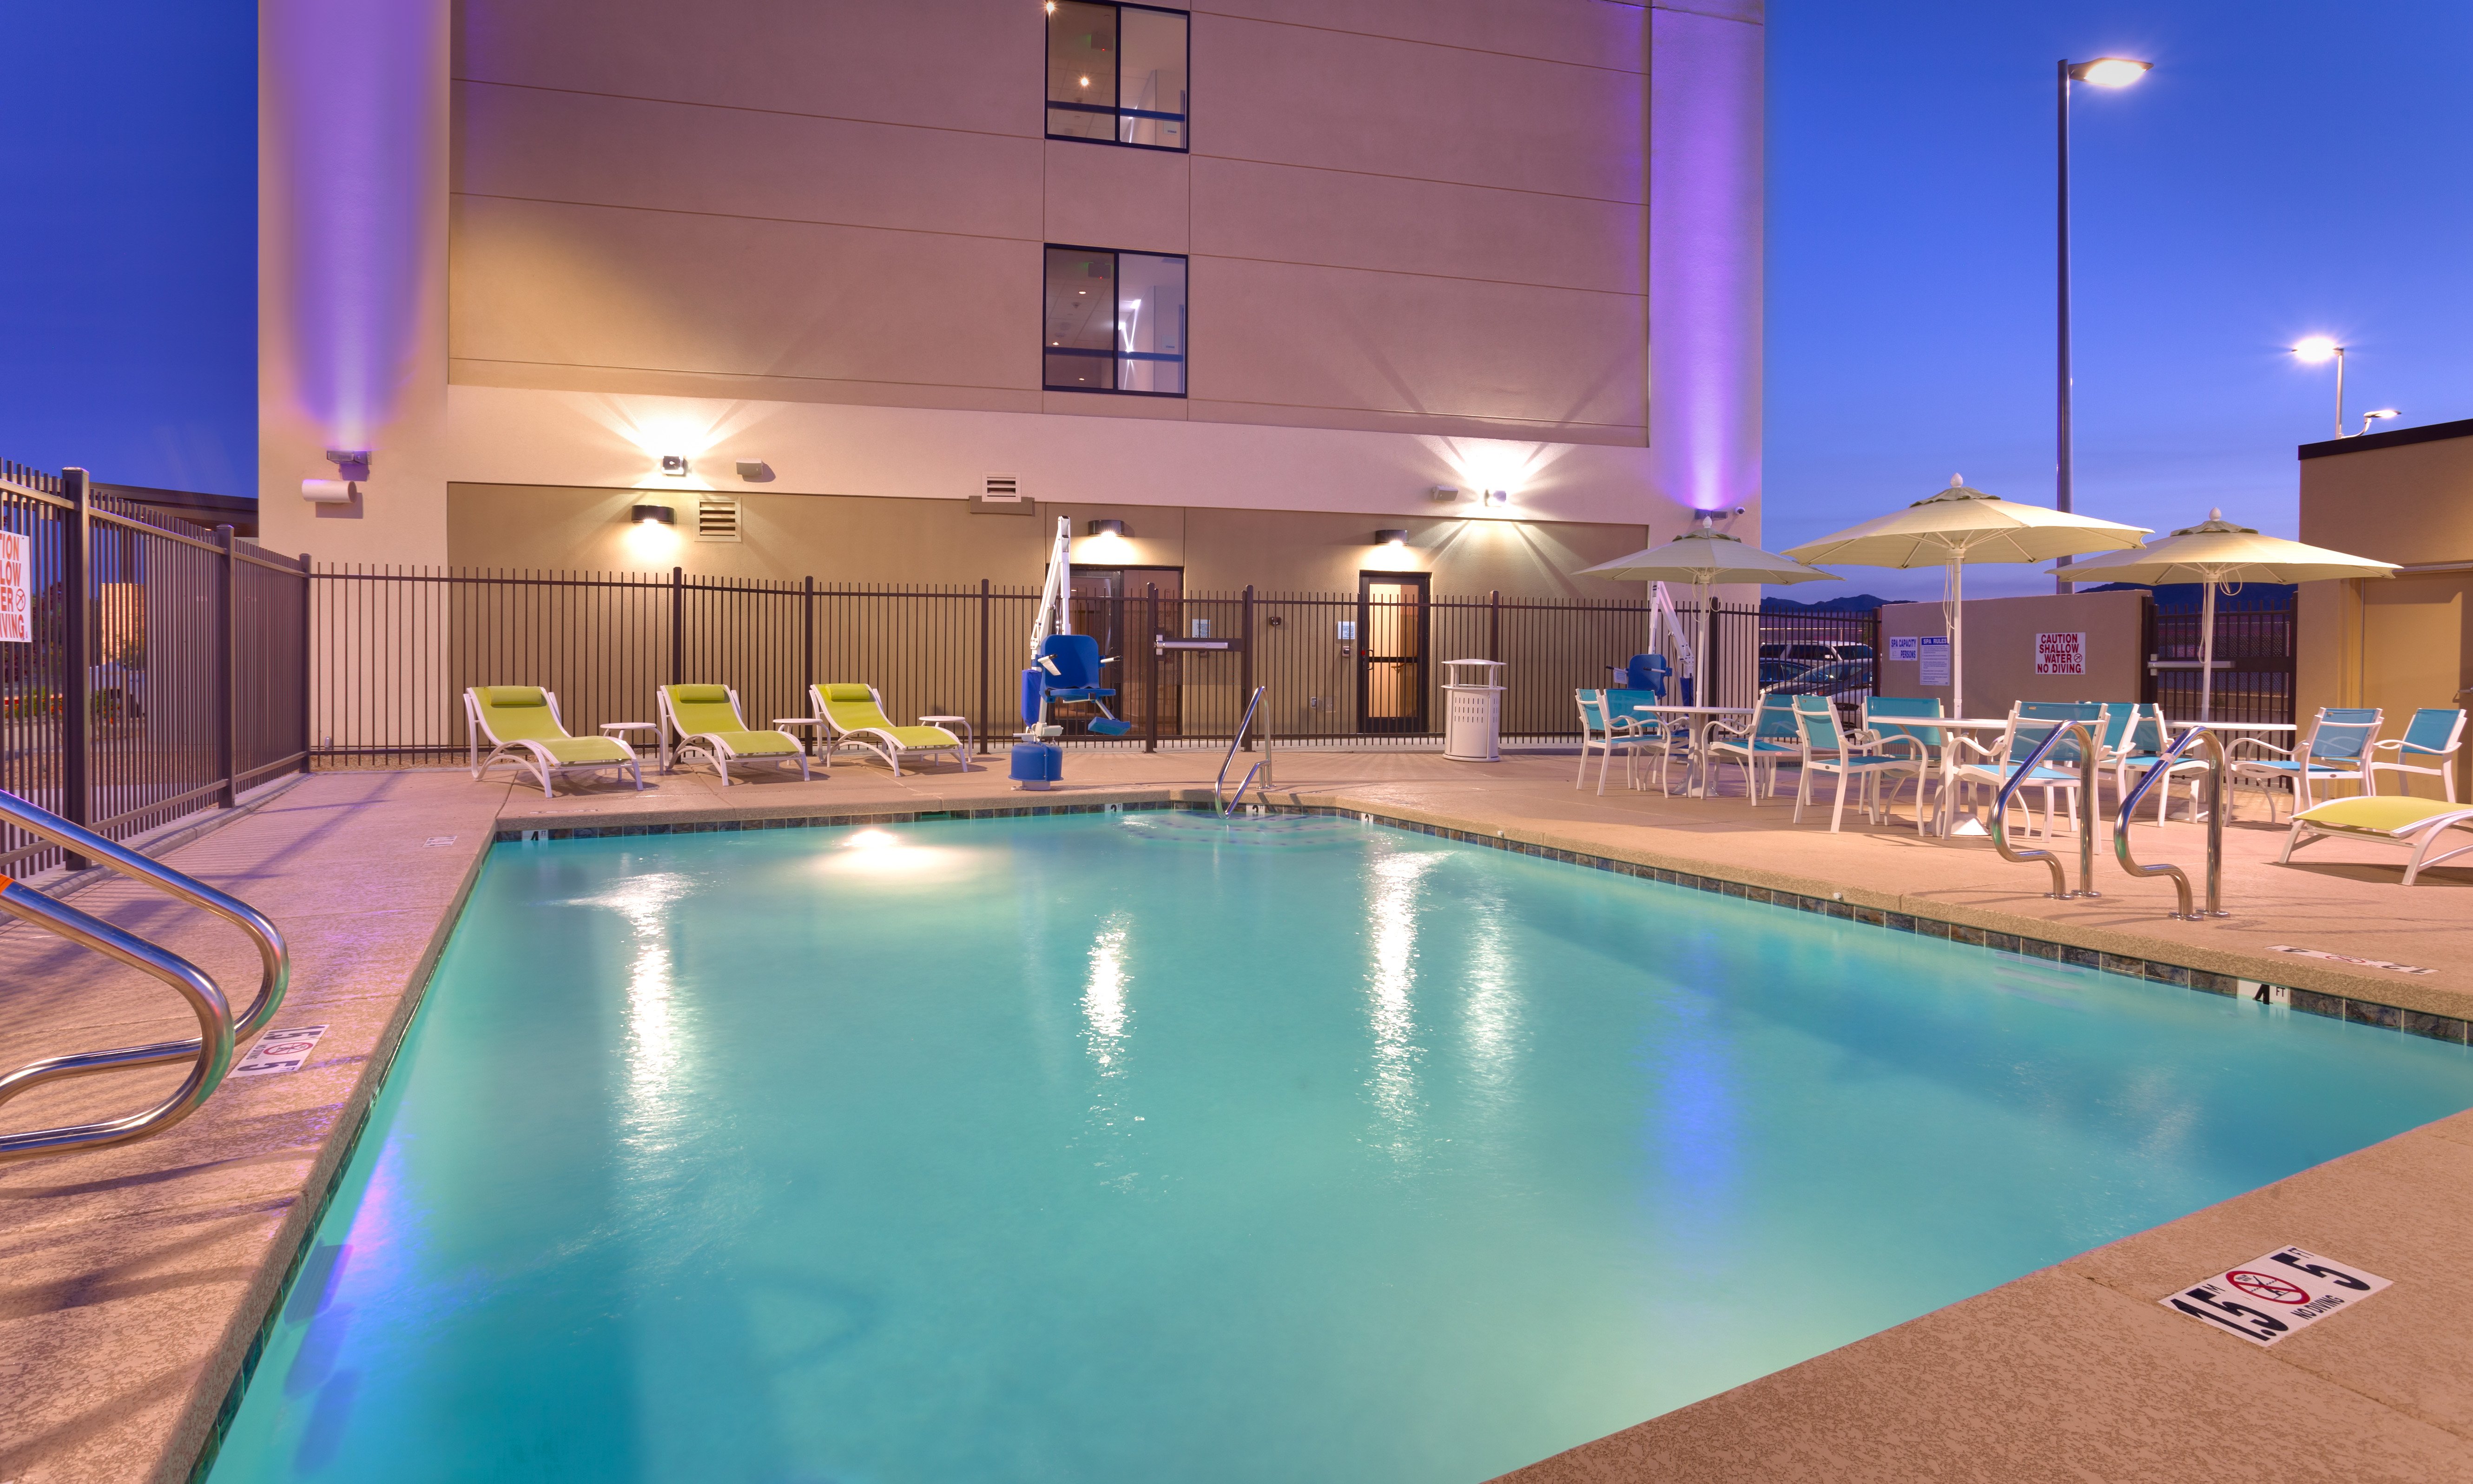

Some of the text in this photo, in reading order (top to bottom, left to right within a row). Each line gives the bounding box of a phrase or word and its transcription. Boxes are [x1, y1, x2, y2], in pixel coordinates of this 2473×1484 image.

[0, 533, 19, 560] ION
[0, 586, 13, 612] ER
[1899, 639, 1916, 647] CAPACITY
[2041, 634, 2077, 644] CAUTION
[1901, 650, 1916, 658] PERSONS
[2039, 644, 2079, 653] SHALLOW
[2044, 654, 2071, 663] WATER
[2038, 663, 2081, 674] NO DIVING
[2276, 986, 2285, 997] FT
[237, 1060, 301, 1071] 5
[2270, 1248, 2371, 1291] 5 FT
[2170, 1283, 2289, 1341] 1.5 M
[2290, 1294, 2345, 1320] NO DIVING
